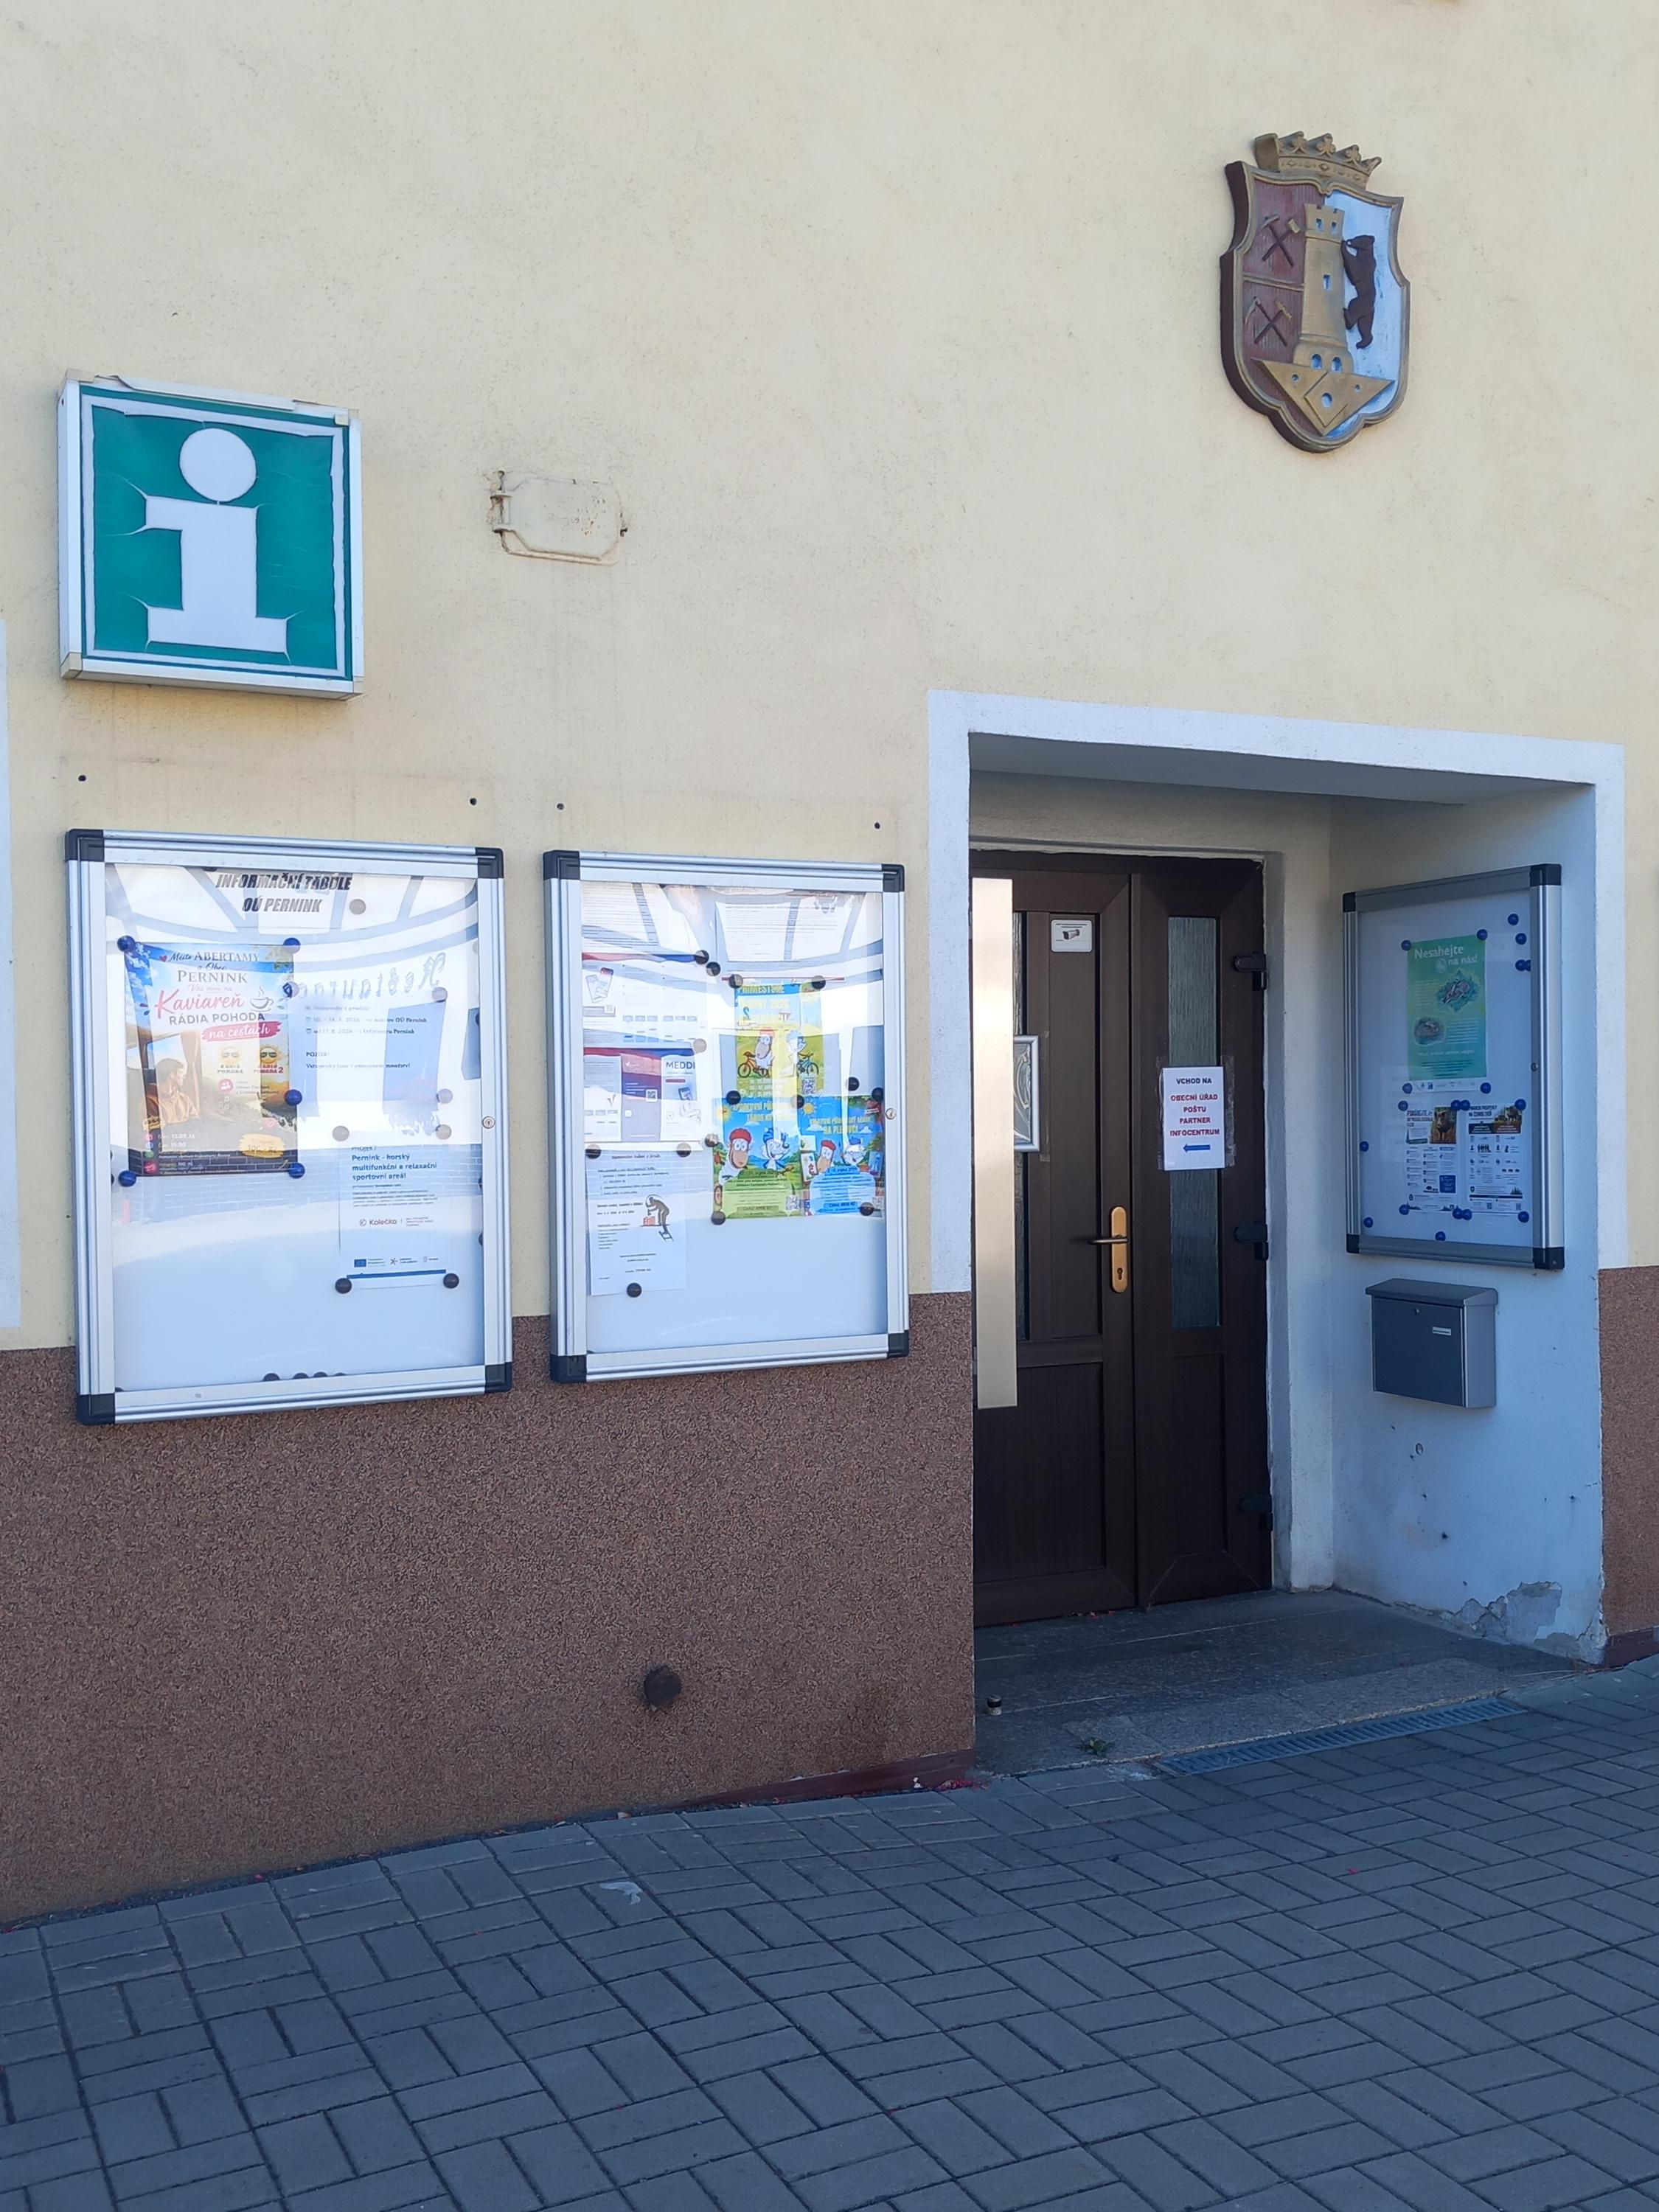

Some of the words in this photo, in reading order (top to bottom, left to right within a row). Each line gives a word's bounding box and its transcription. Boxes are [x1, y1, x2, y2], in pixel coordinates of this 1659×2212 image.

[215, 872, 305, 889] INFORMAČNÍ
[305, 875, 352, 891] TABULE
[243, 895, 262, 912] OÚ
[263, 897, 323, 913] PERNINK
[194, 951, 260, 962] ABERTAMY
[1414, 944, 1464, 959] Nesahejte
[177, 970, 248, 983] PERNINK
[154, 988, 245, 1019] Kaviareň
[169, 1013, 210, 1026] RÁDIA
[212, 1012, 265, 1023] POHODA
[209, 1029, 225, 1040] na
[227, 1021, 271, 1037] cestách
[1170, 1093, 1197, 1102] OBECNÍ
[1199, 1093, 1218, 1101] ÚŘAD
[352, 1173, 386, 1181] sportovní
[369, 1217, 397, 1226] Kolečko
